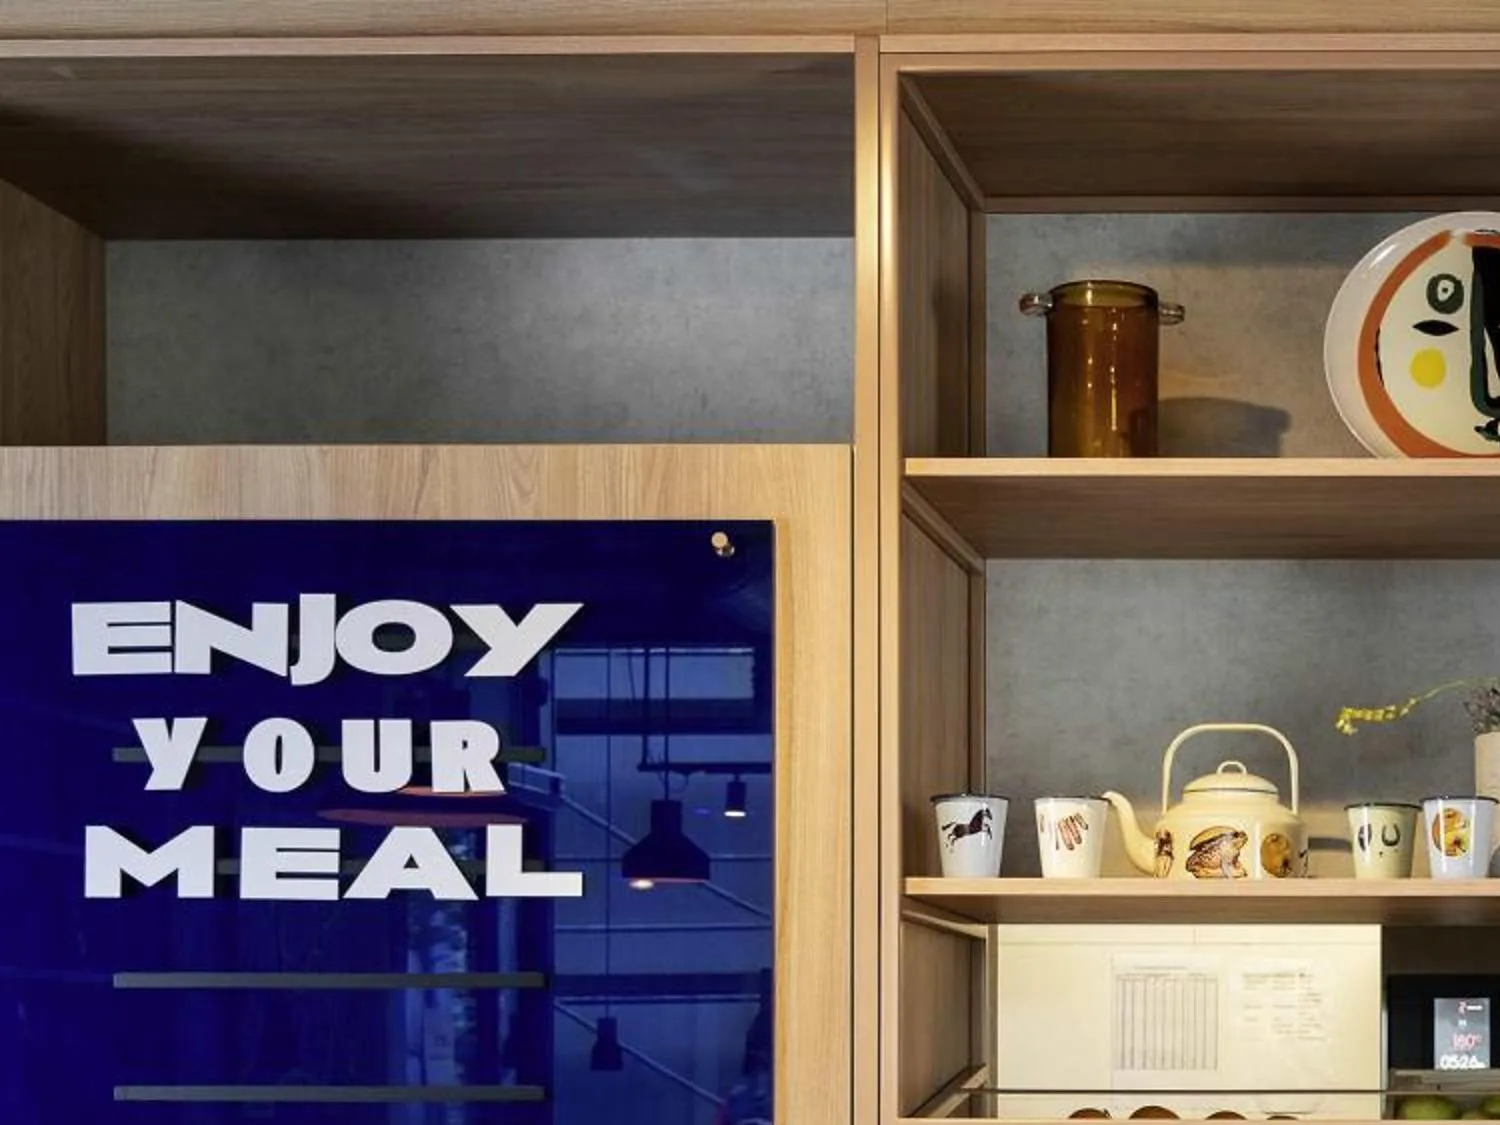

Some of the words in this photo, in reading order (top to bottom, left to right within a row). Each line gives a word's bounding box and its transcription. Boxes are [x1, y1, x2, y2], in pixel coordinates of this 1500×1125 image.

[71, 593, 584, 686] ENJOY
[132, 717, 506, 793] YOUR
[84, 823, 584, 901] MEAL
